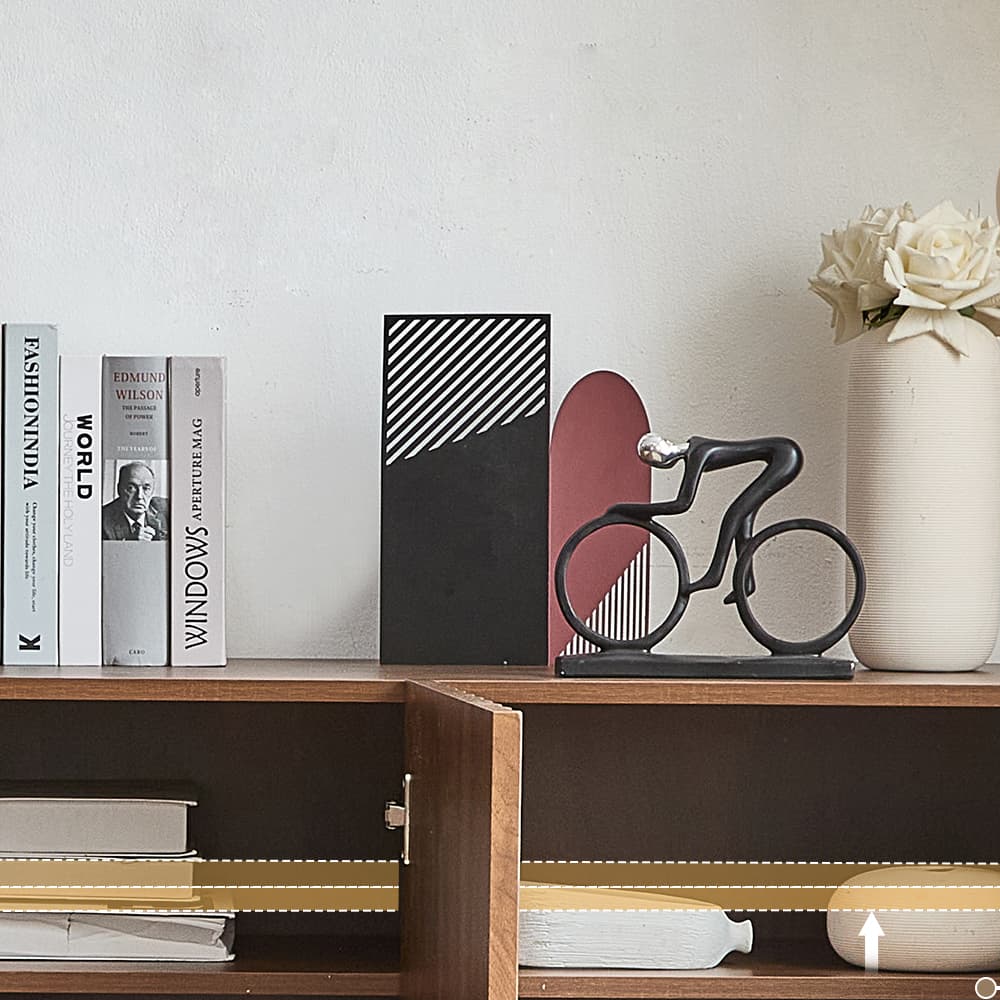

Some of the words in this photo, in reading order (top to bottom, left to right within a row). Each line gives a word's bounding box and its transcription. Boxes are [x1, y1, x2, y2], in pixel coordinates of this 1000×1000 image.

[113, 372, 166, 383] EDMUND
[115, 389, 163, 400] WILSON
[193, 367, 201, 397] aperture
[23, 337, 40, 490] FASHIONINDIA
[62, 414, 75, 470] JOURNEY
[191, 418, 203, 450] MAG
[77, 414, 93, 500] WORLD
[62, 475, 75, 498] THE
[191, 451, 203, 521] APERTURE
[62, 499, 75, 533] HOLY
[62, 533, 75, 568] LAND
[184, 526, 209, 650] WINDOWS
[19, 634, 41, 651] K
